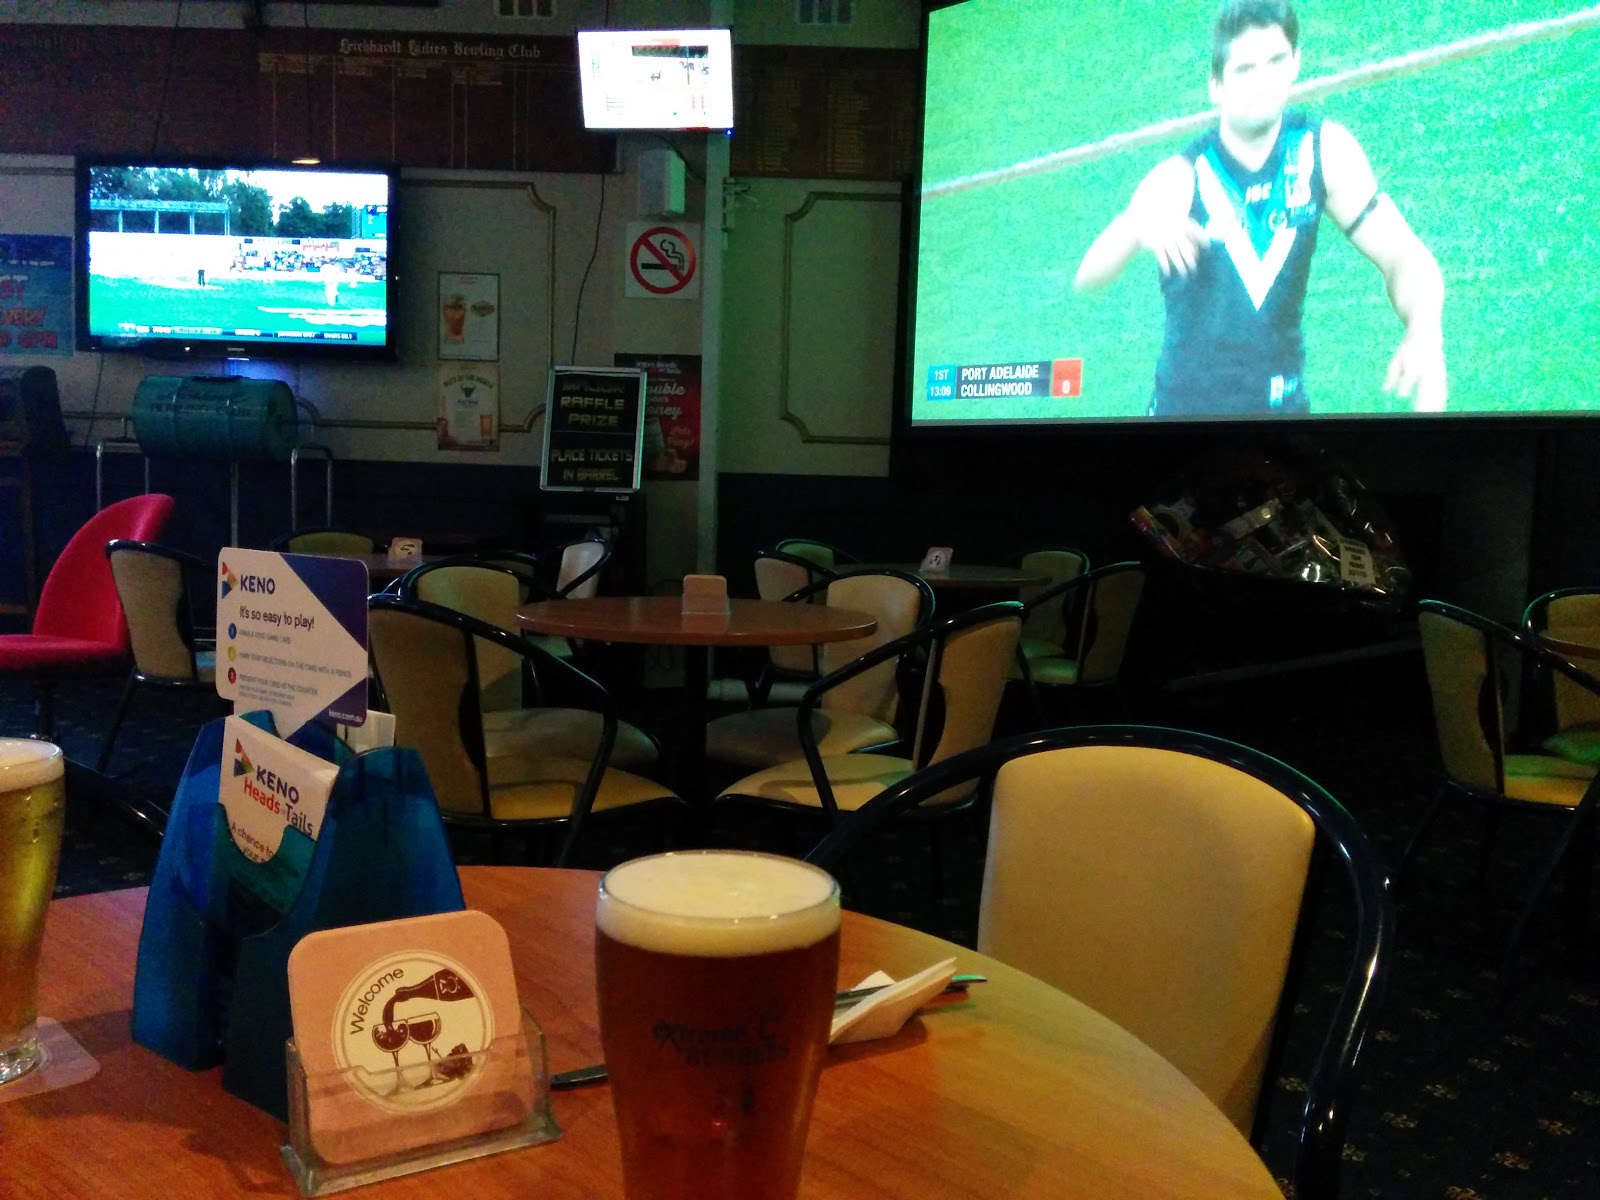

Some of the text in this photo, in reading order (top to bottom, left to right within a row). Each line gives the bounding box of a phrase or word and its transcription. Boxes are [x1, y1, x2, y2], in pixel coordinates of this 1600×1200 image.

[338, 37, 541, 60] Leichhardt Ladies Bowling Club
[934, 365, 1039, 381] 1ST PORT ADELAIDE
[646, 383, 687, 396] ouble
[930, 380, 1071, 398] 13:09 COLLINGWOOD 0
[559, 396, 625, 410] RAFFLE
[567, 413, 620, 427] PRIZE
[551, 448, 633, 462] PLACE TICKETS
[562, 468, 574, 481] IN
[240, 574, 276, 595] KENO
[239, 605, 315, 631] It's so easy to play!
[256, 765, 300, 804] KENO
[243, 776, 314, 836] Heads Tails
[231, 821, 275, 858] A chance to
[349, 967, 405, 1036] Welcome
